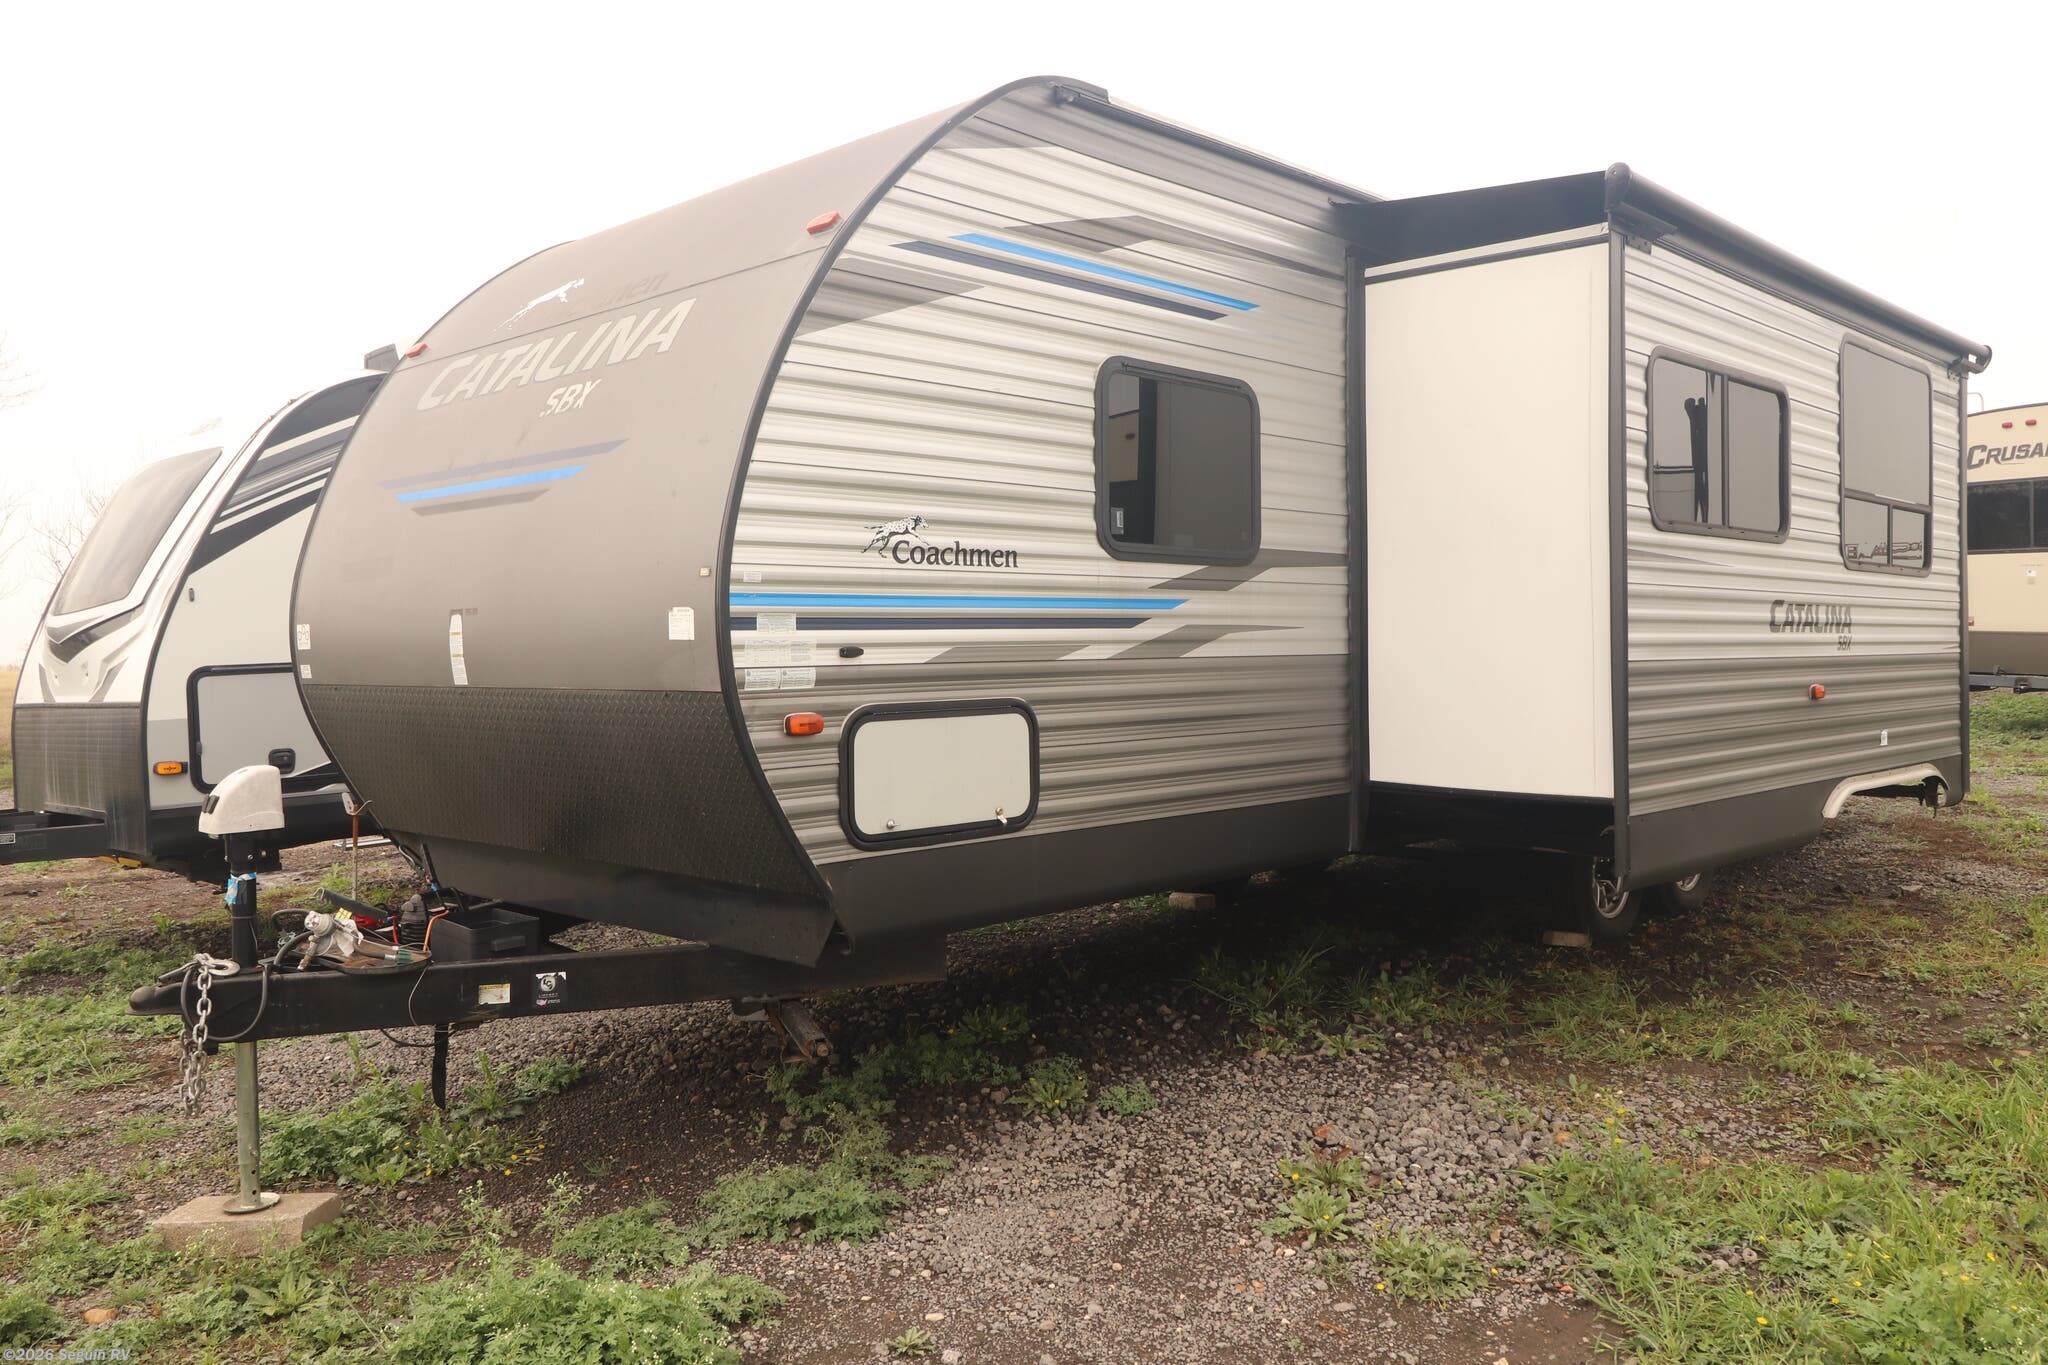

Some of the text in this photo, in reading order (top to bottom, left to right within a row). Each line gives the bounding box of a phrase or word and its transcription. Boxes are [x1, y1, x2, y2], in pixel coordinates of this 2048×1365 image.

[417, 297, 696, 411] CATALINA
[540, 378, 602, 416] SBX
[1967, 442, 2048, 470] CRUSA
[892, 539, 1018, 568] Coachmen
[1769, 600, 1852, 633] CATALINA
[1837, 635, 1852, 651] SBX
